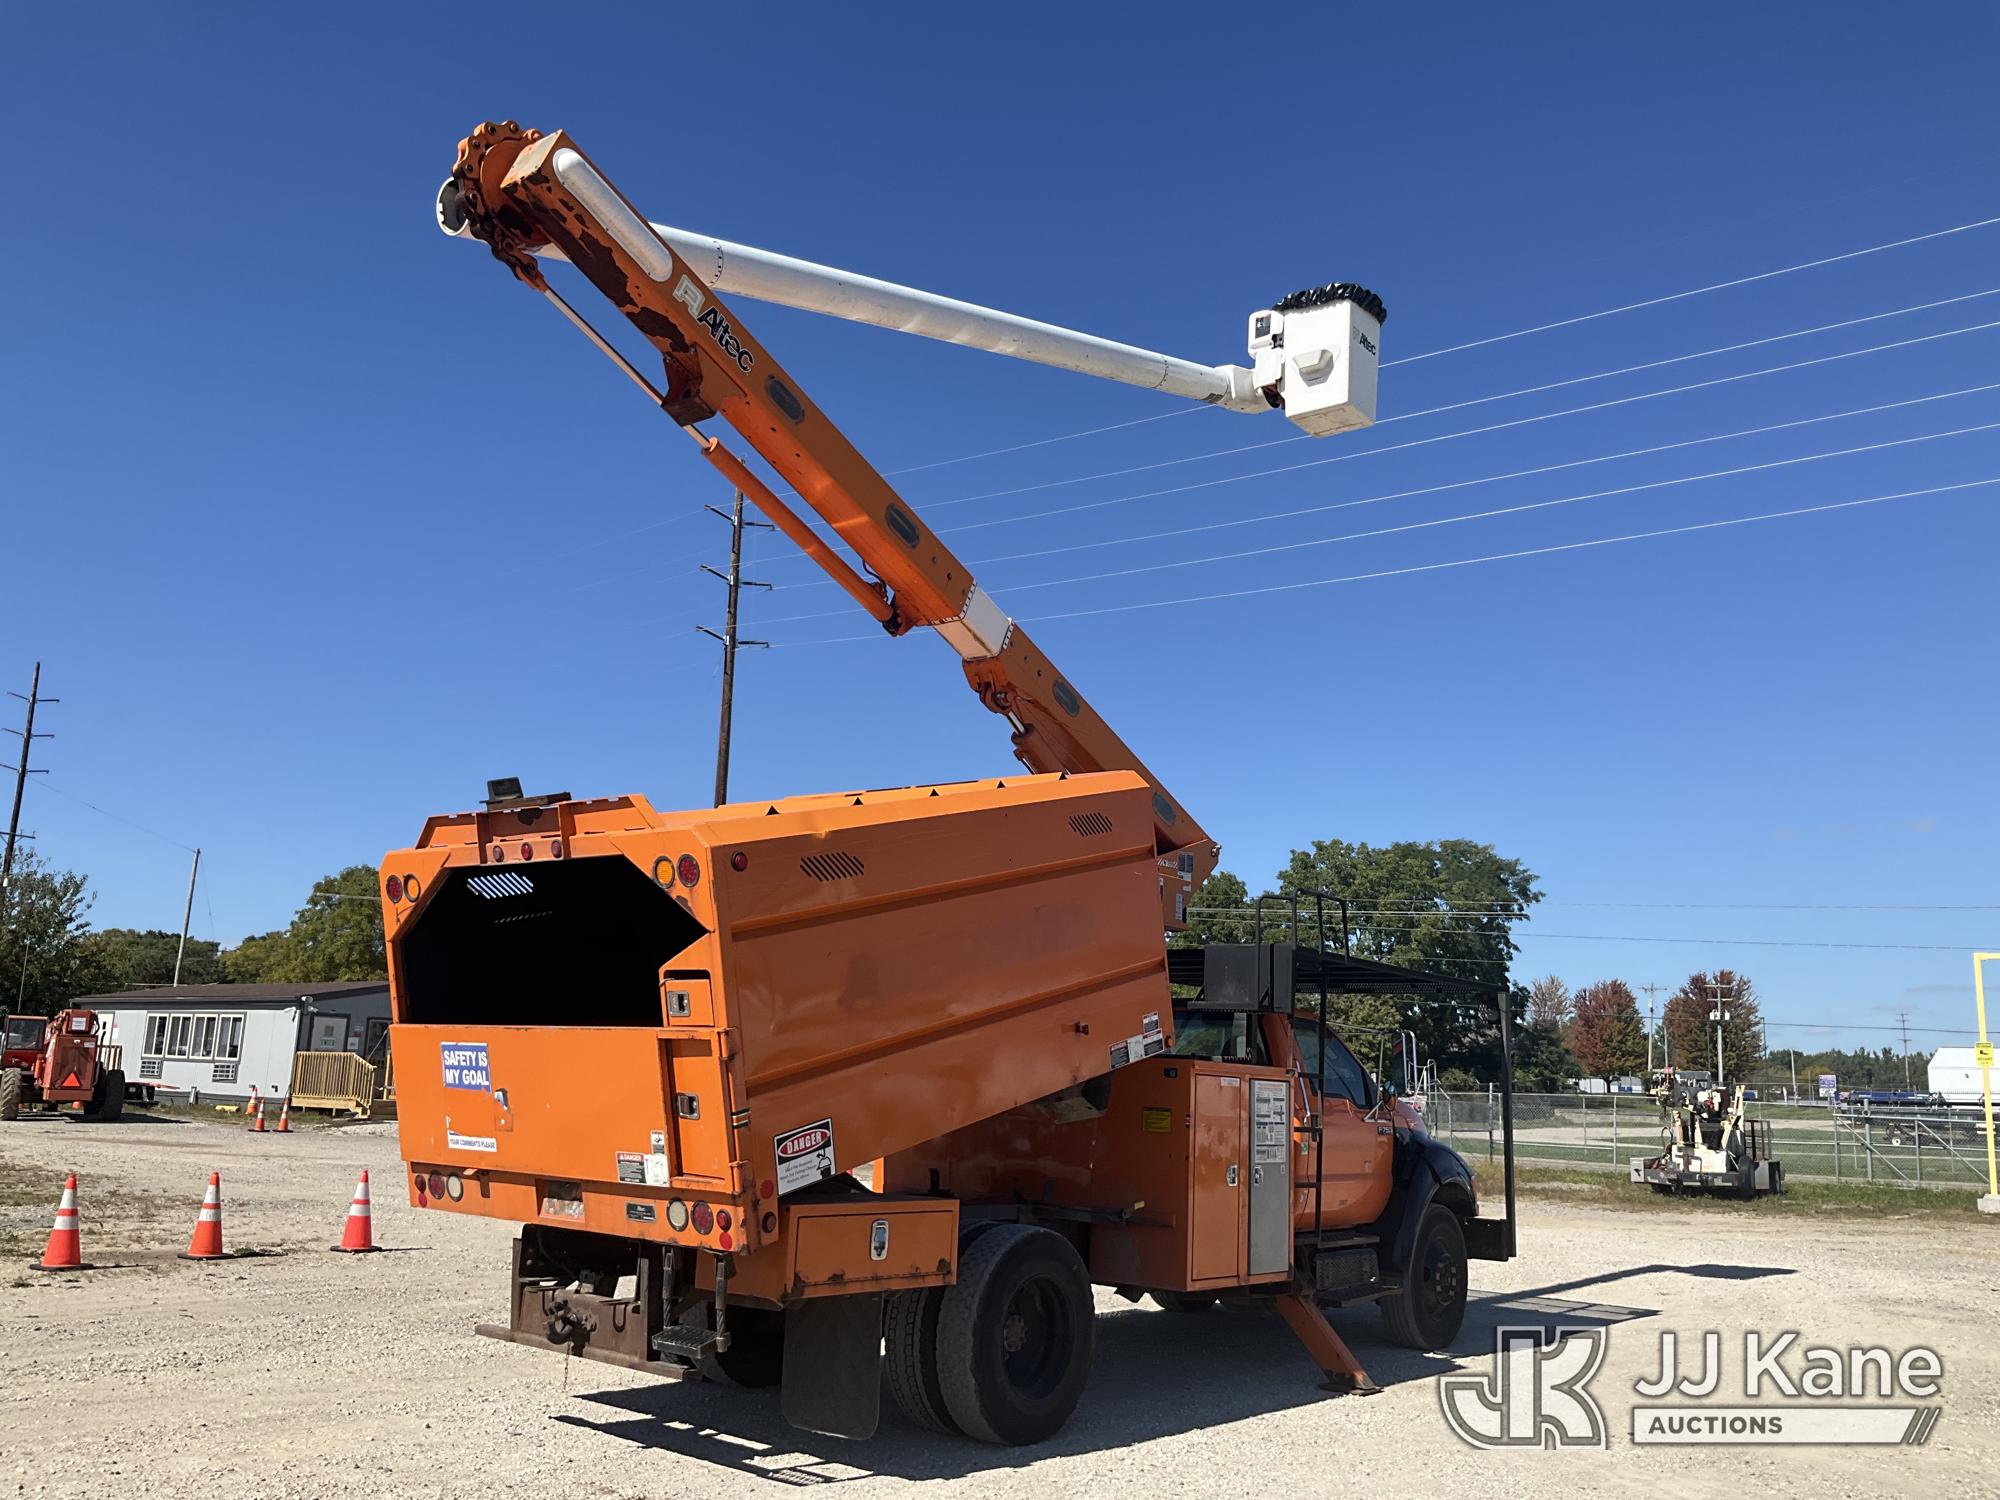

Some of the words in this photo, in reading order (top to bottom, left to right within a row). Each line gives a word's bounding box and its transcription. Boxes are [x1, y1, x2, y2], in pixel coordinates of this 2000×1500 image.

[697, 306, 754, 372] Altec
[1359, 333, 1377, 356] Altec
[443, 1050, 477, 1066] SAFETY
[478, 1051, 488, 1067] IS
[445, 1069, 461, 1085] MY
[462, 1069, 490, 1086] GOAL
[786, 1131, 822, 1154] DANGER
